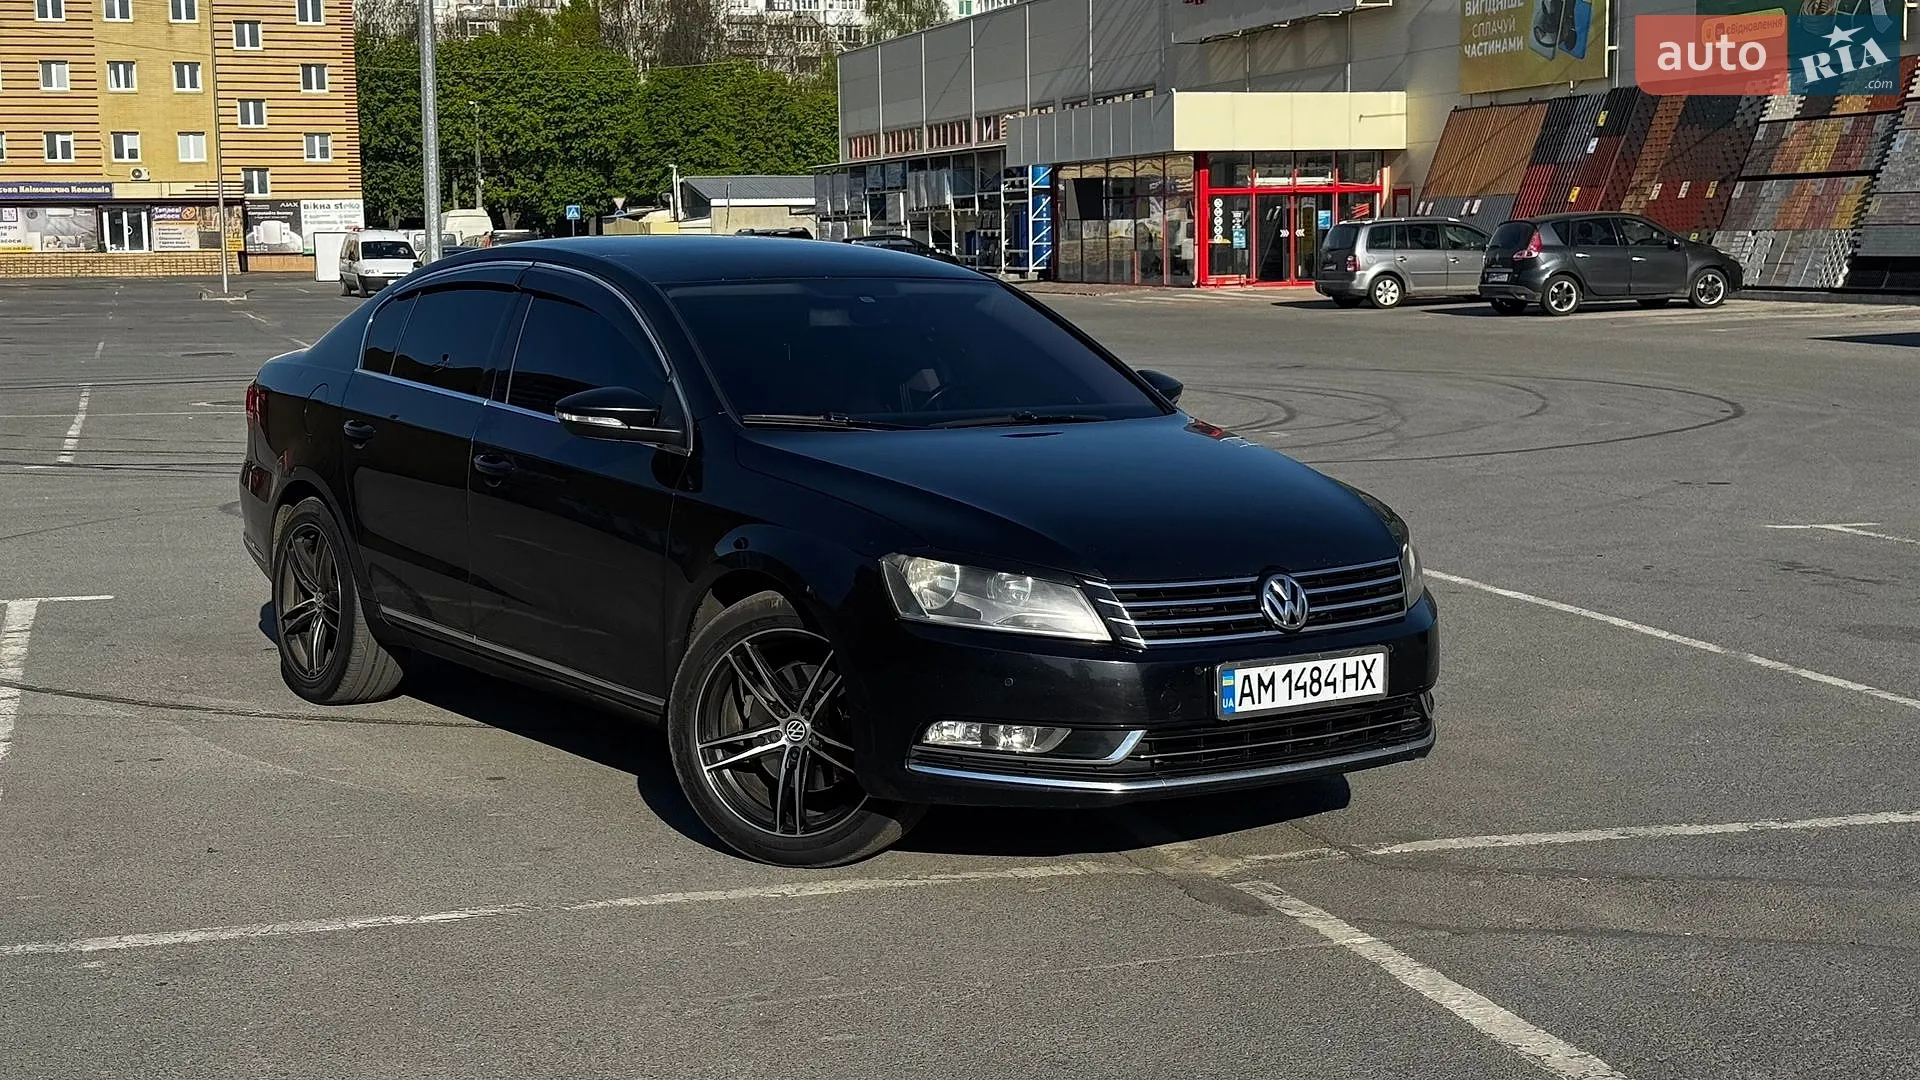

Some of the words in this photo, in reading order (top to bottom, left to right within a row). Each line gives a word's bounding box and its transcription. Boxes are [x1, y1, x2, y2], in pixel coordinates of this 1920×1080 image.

[1472, 15, 1516, 38] СПЛАЧУЙ
[1726, 18, 1783, 36] єВідновлення
[1464, 36, 1524, 58] ЧАСТИНАМИ
[1238, 671, 1276, 707] AM
[1281, 663, 1337, 700] 1484
[1342, 658, 1377, 693] HX
[1222, 699, 1235, 708] UA
